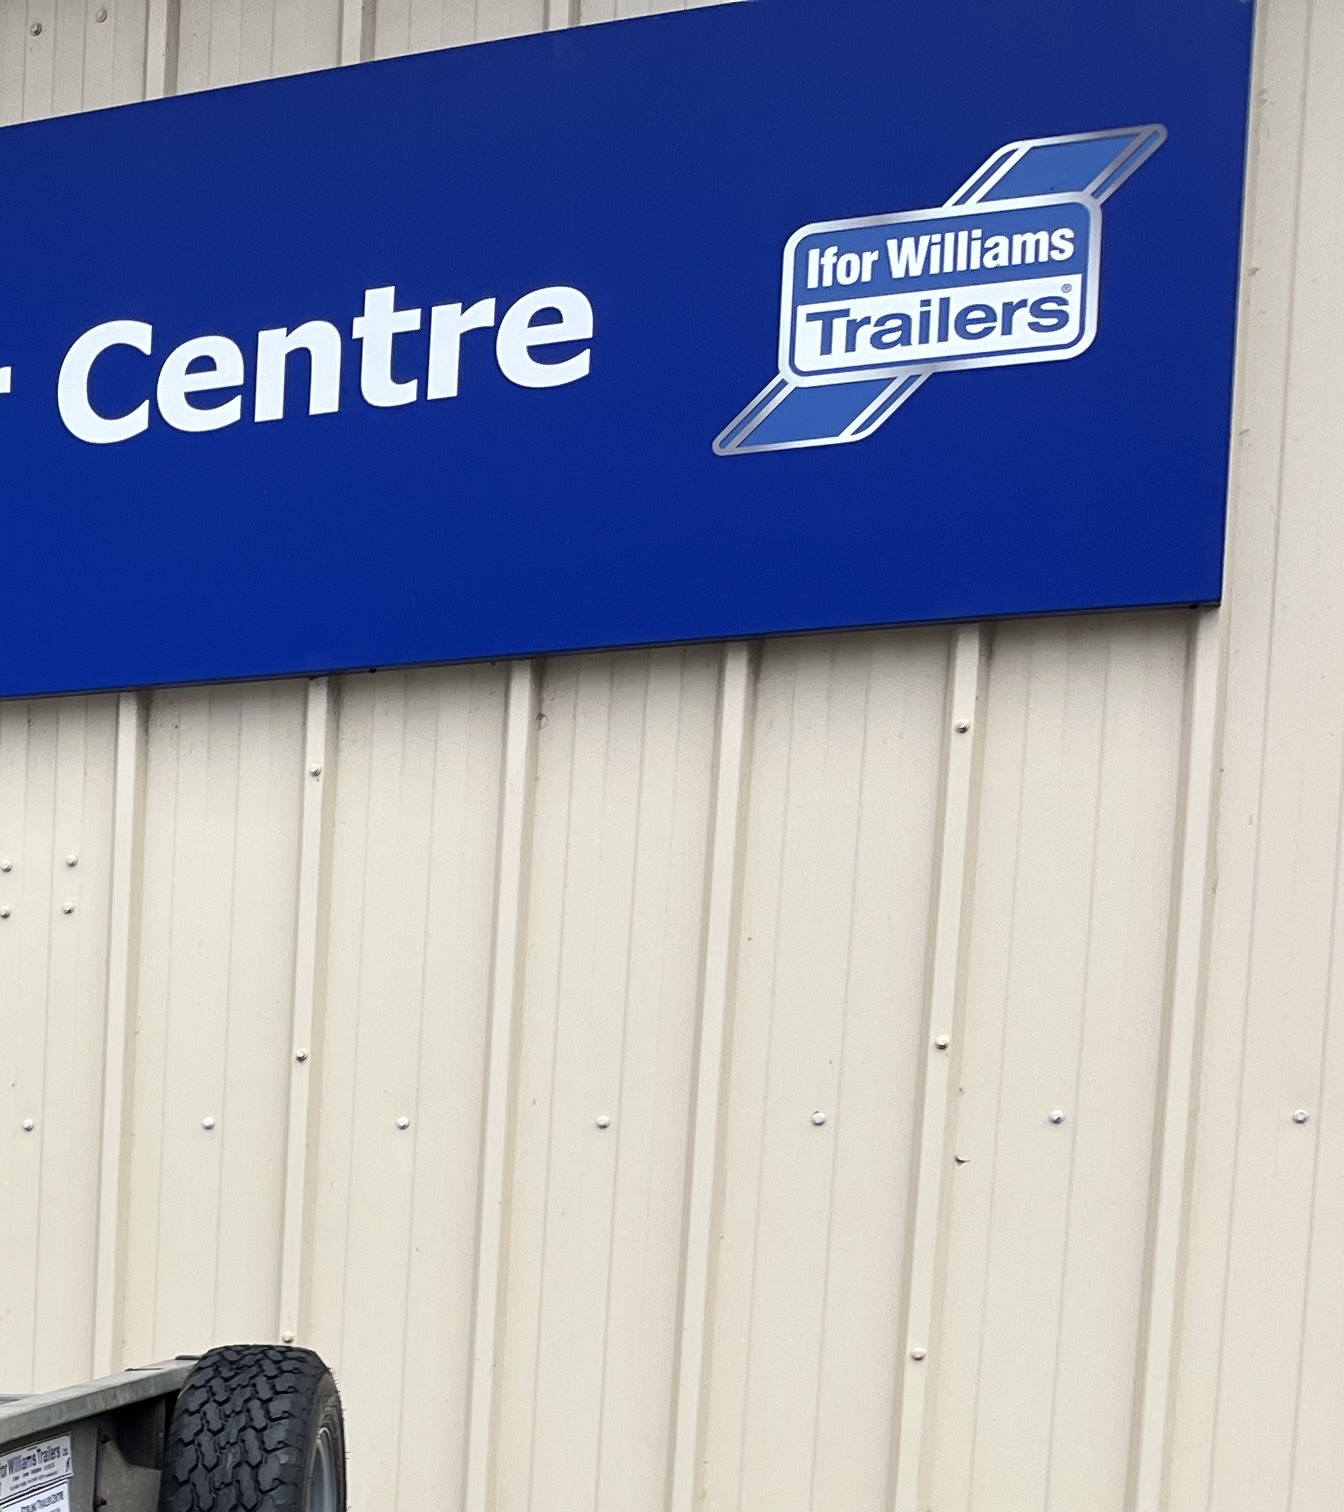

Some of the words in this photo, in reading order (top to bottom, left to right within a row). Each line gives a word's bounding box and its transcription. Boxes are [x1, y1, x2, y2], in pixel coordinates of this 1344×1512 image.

[806, 245, 879, 289] Ifor
[887, 226, 1075, 279] Williams
[805, 294, 1070, 357] Trailers
[57, 284, 596, 445] Centre
